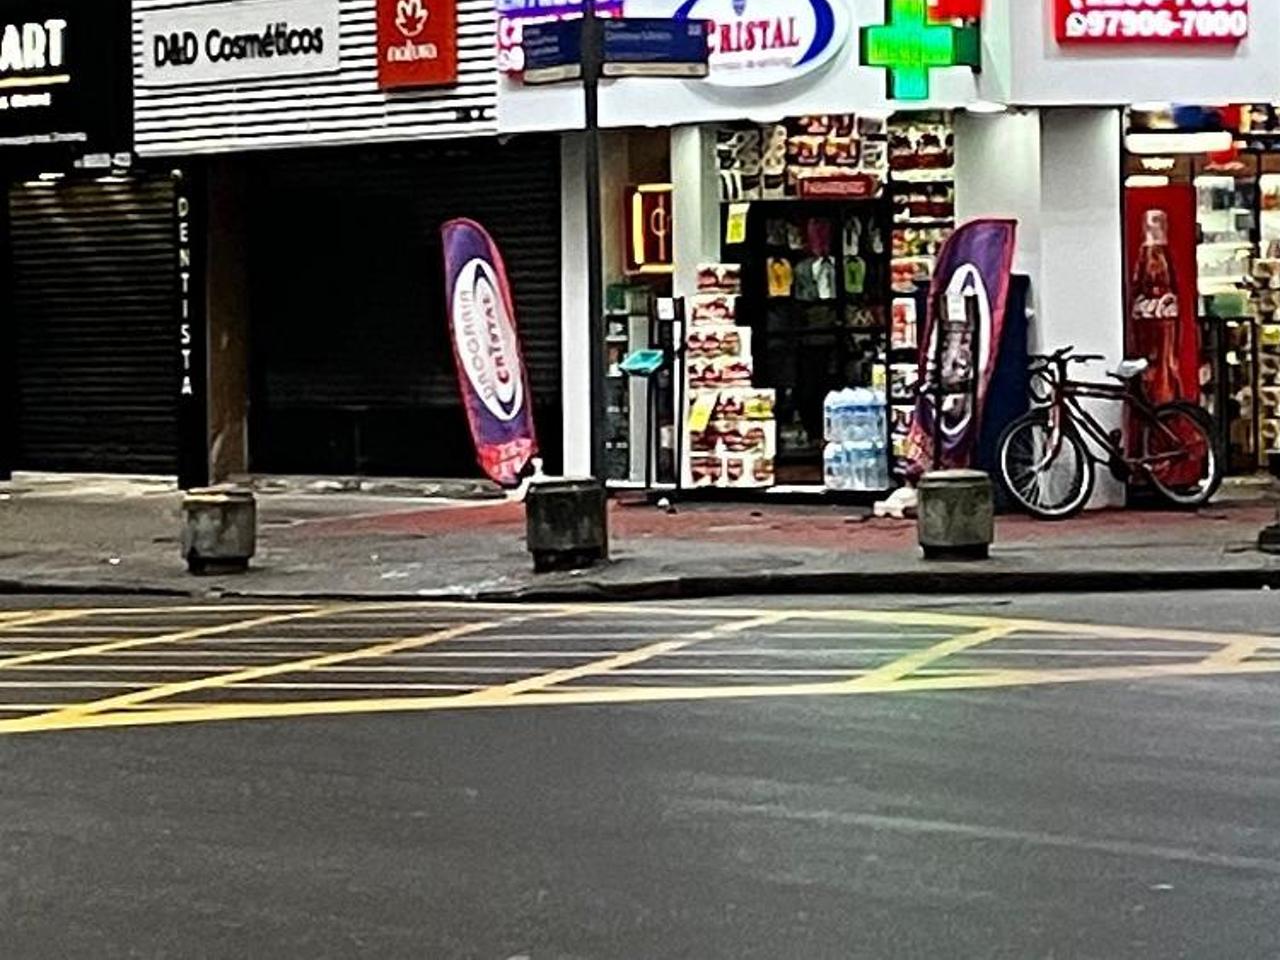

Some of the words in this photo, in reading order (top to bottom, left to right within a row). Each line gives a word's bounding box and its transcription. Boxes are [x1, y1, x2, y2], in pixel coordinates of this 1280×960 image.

[154, 31, 198, 67] D&D
[205, 22, 324, 63] Cosméticos
[177, 197, 192, 395] DENTISTA
